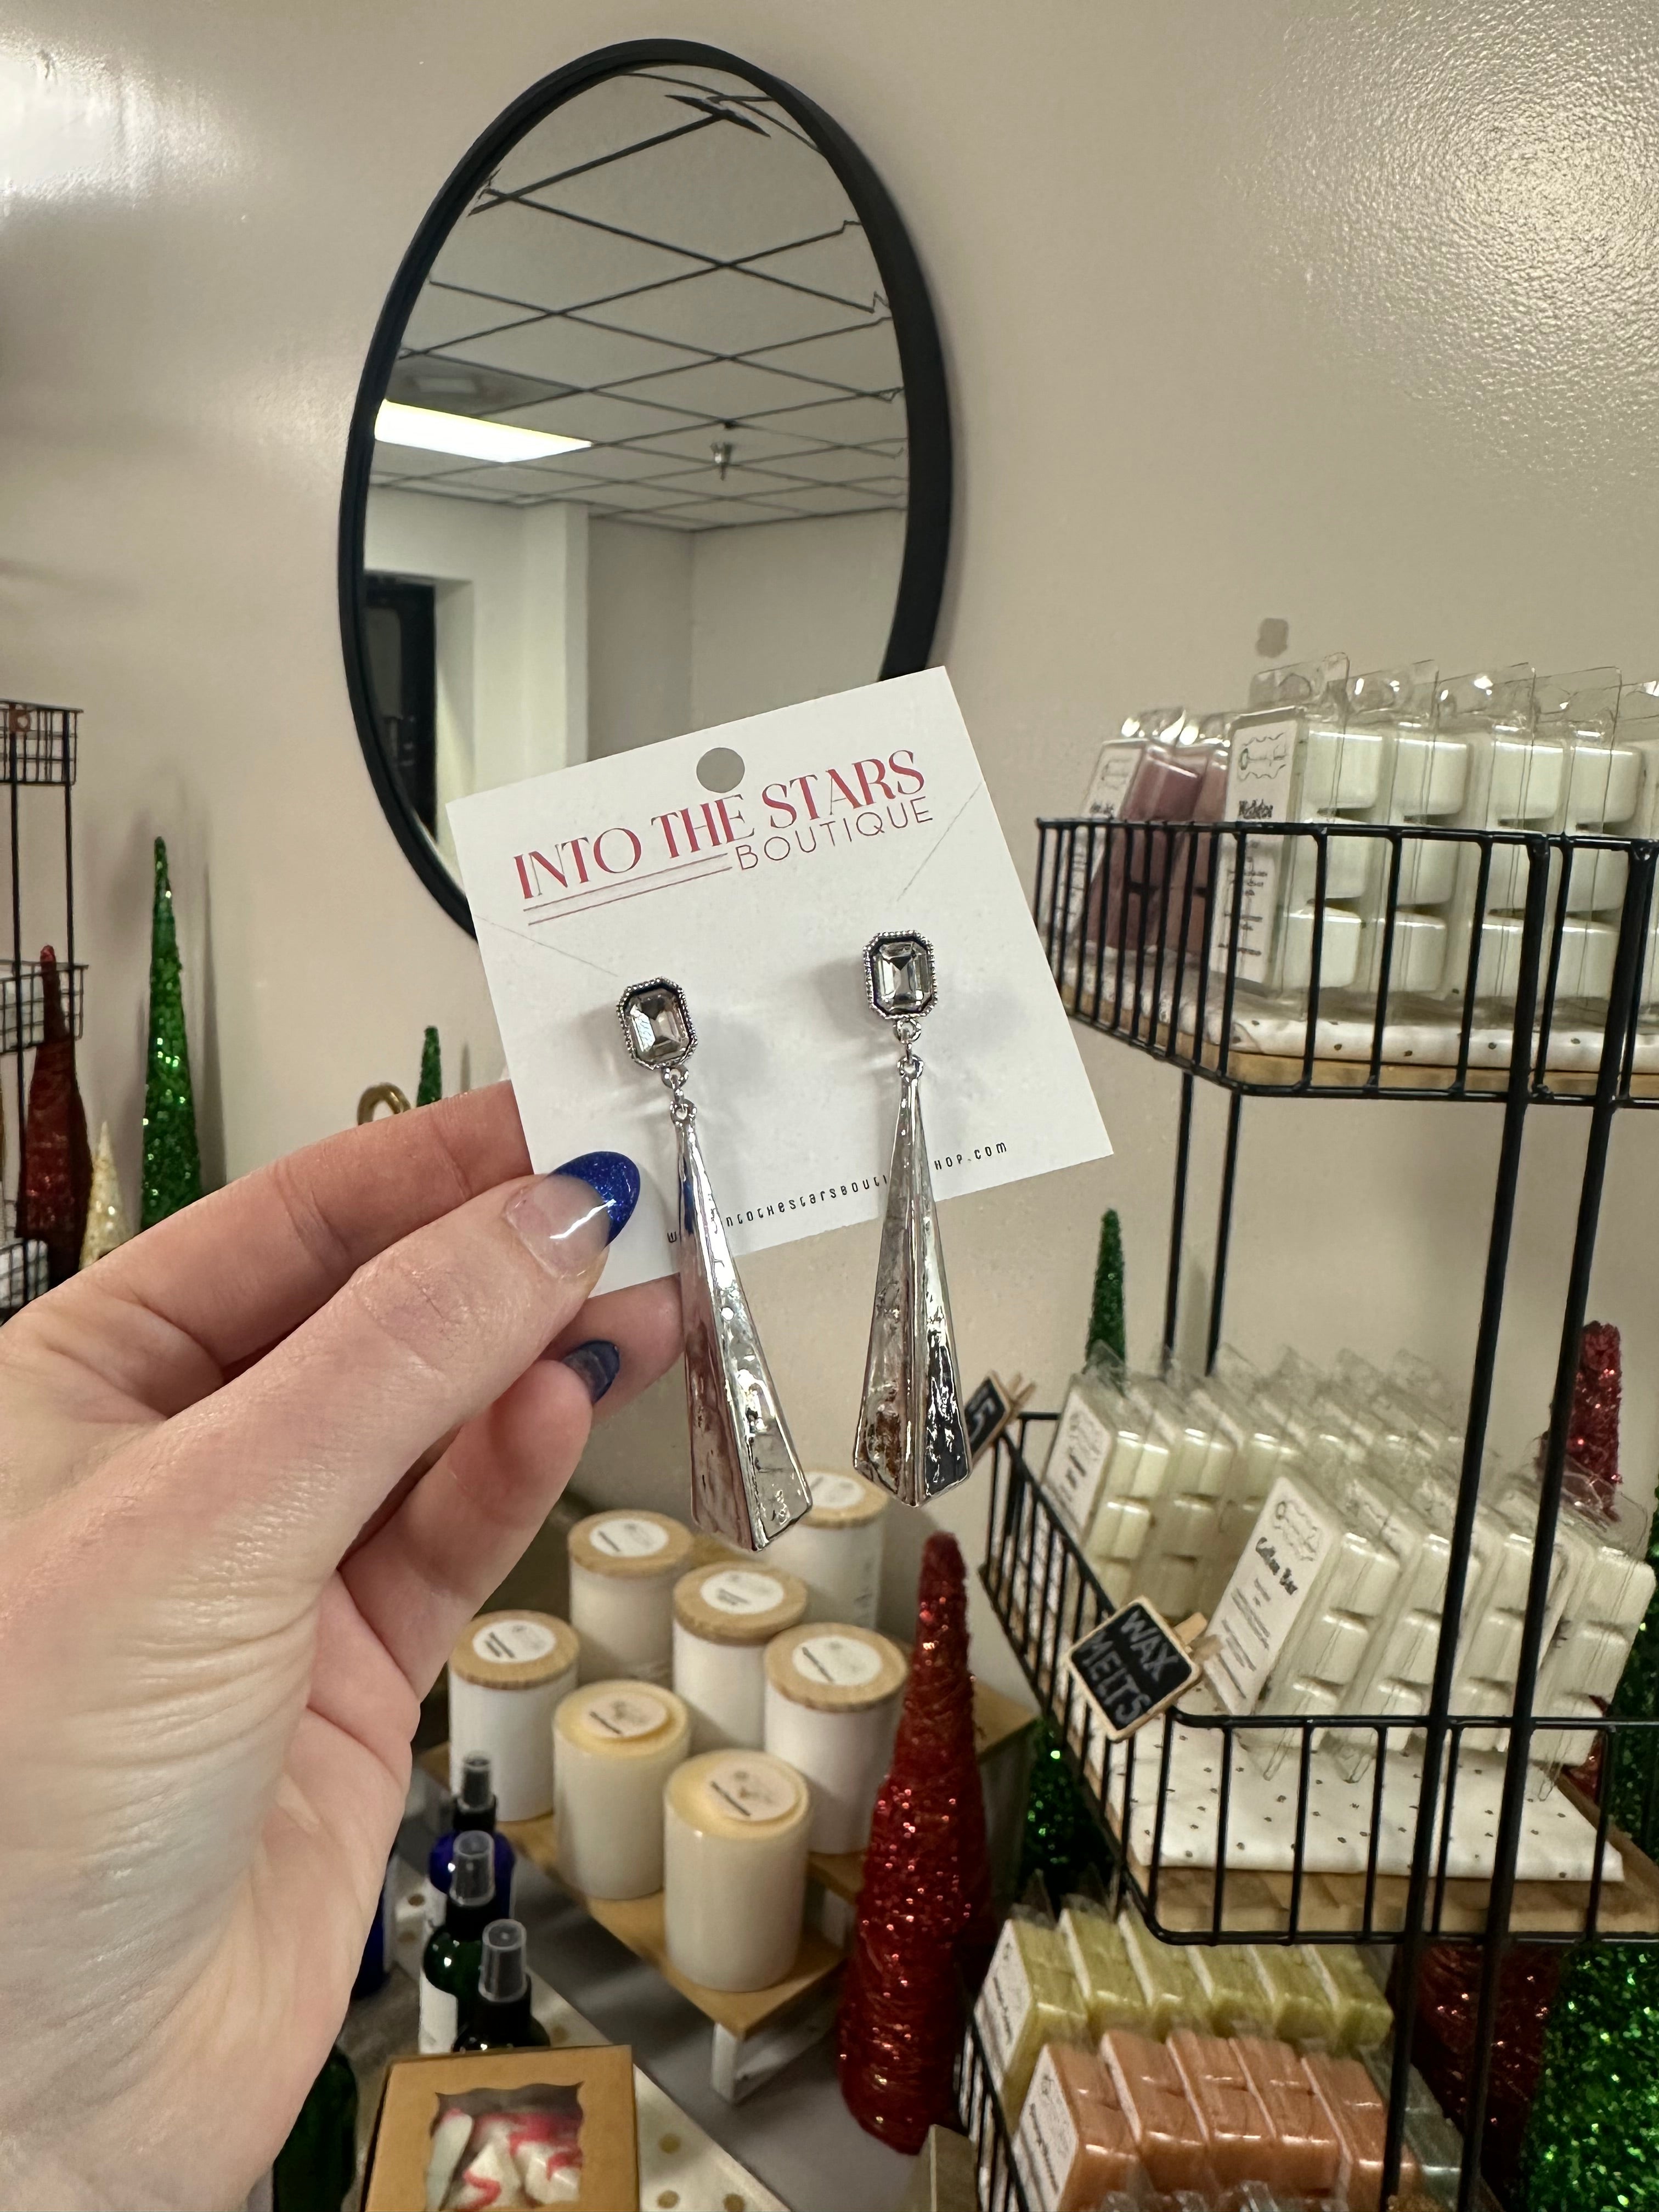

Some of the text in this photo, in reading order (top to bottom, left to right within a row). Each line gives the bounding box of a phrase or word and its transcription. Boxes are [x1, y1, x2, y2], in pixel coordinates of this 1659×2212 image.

[514, 749, 924, 900] INTO THE STARS
[735, 795, 933, 871] BOUTIQUE
[1077, 1630, 1152, 1724] MELTS
[1120, 1609, 1179, 1682] WAX
